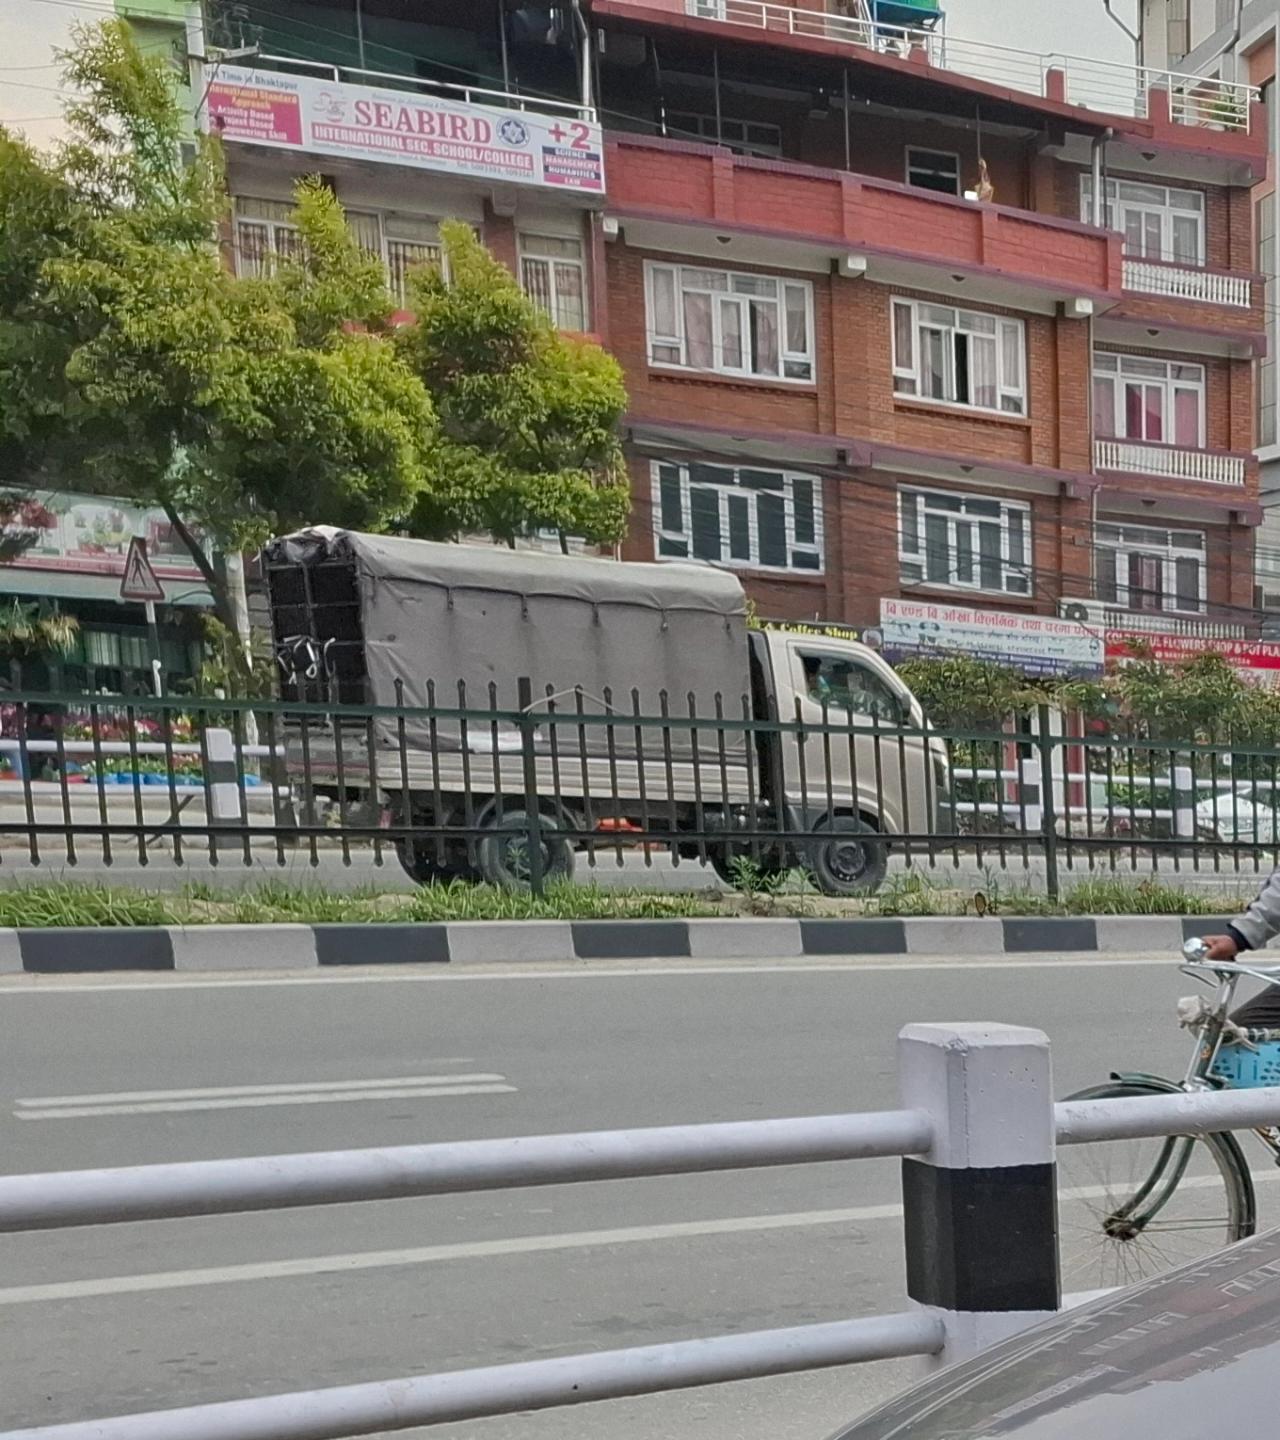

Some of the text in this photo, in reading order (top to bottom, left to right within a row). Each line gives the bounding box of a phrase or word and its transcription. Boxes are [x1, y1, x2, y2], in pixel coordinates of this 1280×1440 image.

[354, 99, 492, 144] SEABIRD
[549, 123, 591, 150] +2
[314, 123, 405, 150] INTERNATIONAL
[405, 138, 432, 154] SEC.
[432, 142, 532, 170] SCHOOL/COLLEGE
[545, 156, 600, 170] MANAGEMENT
[548, 166, 596, 179] HUMANITIES
[824, 626, 858, 641] Shop
[1162, 636, 1206, 650] FLOWERS
[1234, 642, 1241, 654] &
